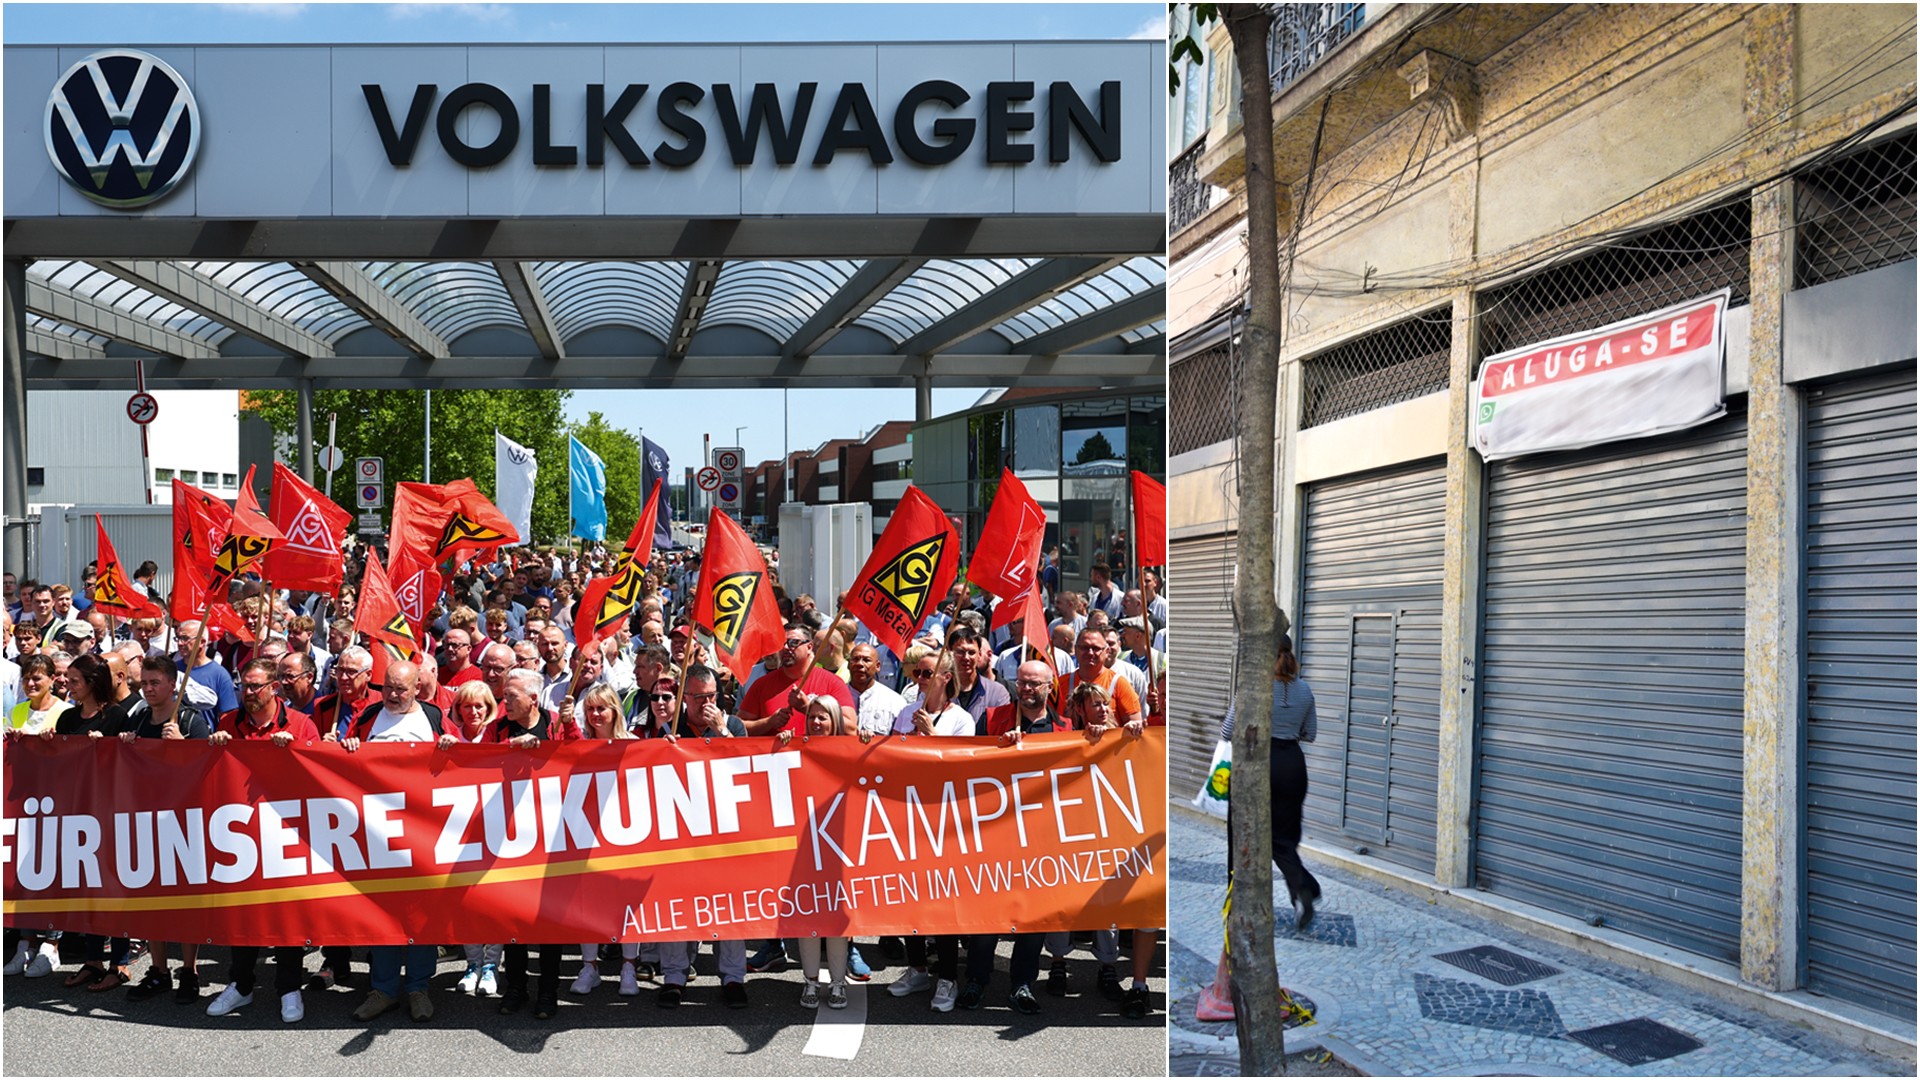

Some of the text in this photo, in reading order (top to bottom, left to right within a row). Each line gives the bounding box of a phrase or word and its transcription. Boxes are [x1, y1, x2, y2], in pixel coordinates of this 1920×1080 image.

[361, 79, 1121, 168] VOLKSWAGEN
[1501, 316, 1689, 390] ALUGA-SE
[365, 464, 374, 472] 30
[723, 457, 734, 466] 30
[114, 792, 412, 889] UNSERE
[432, 752, 802, 864] ZUKUNFT
[806, 759, 1144, 871] KÄMPFEN
[621, 845, 1154, 937] ALLE BELEGSCHAFTEN IM VW-KONZERN
